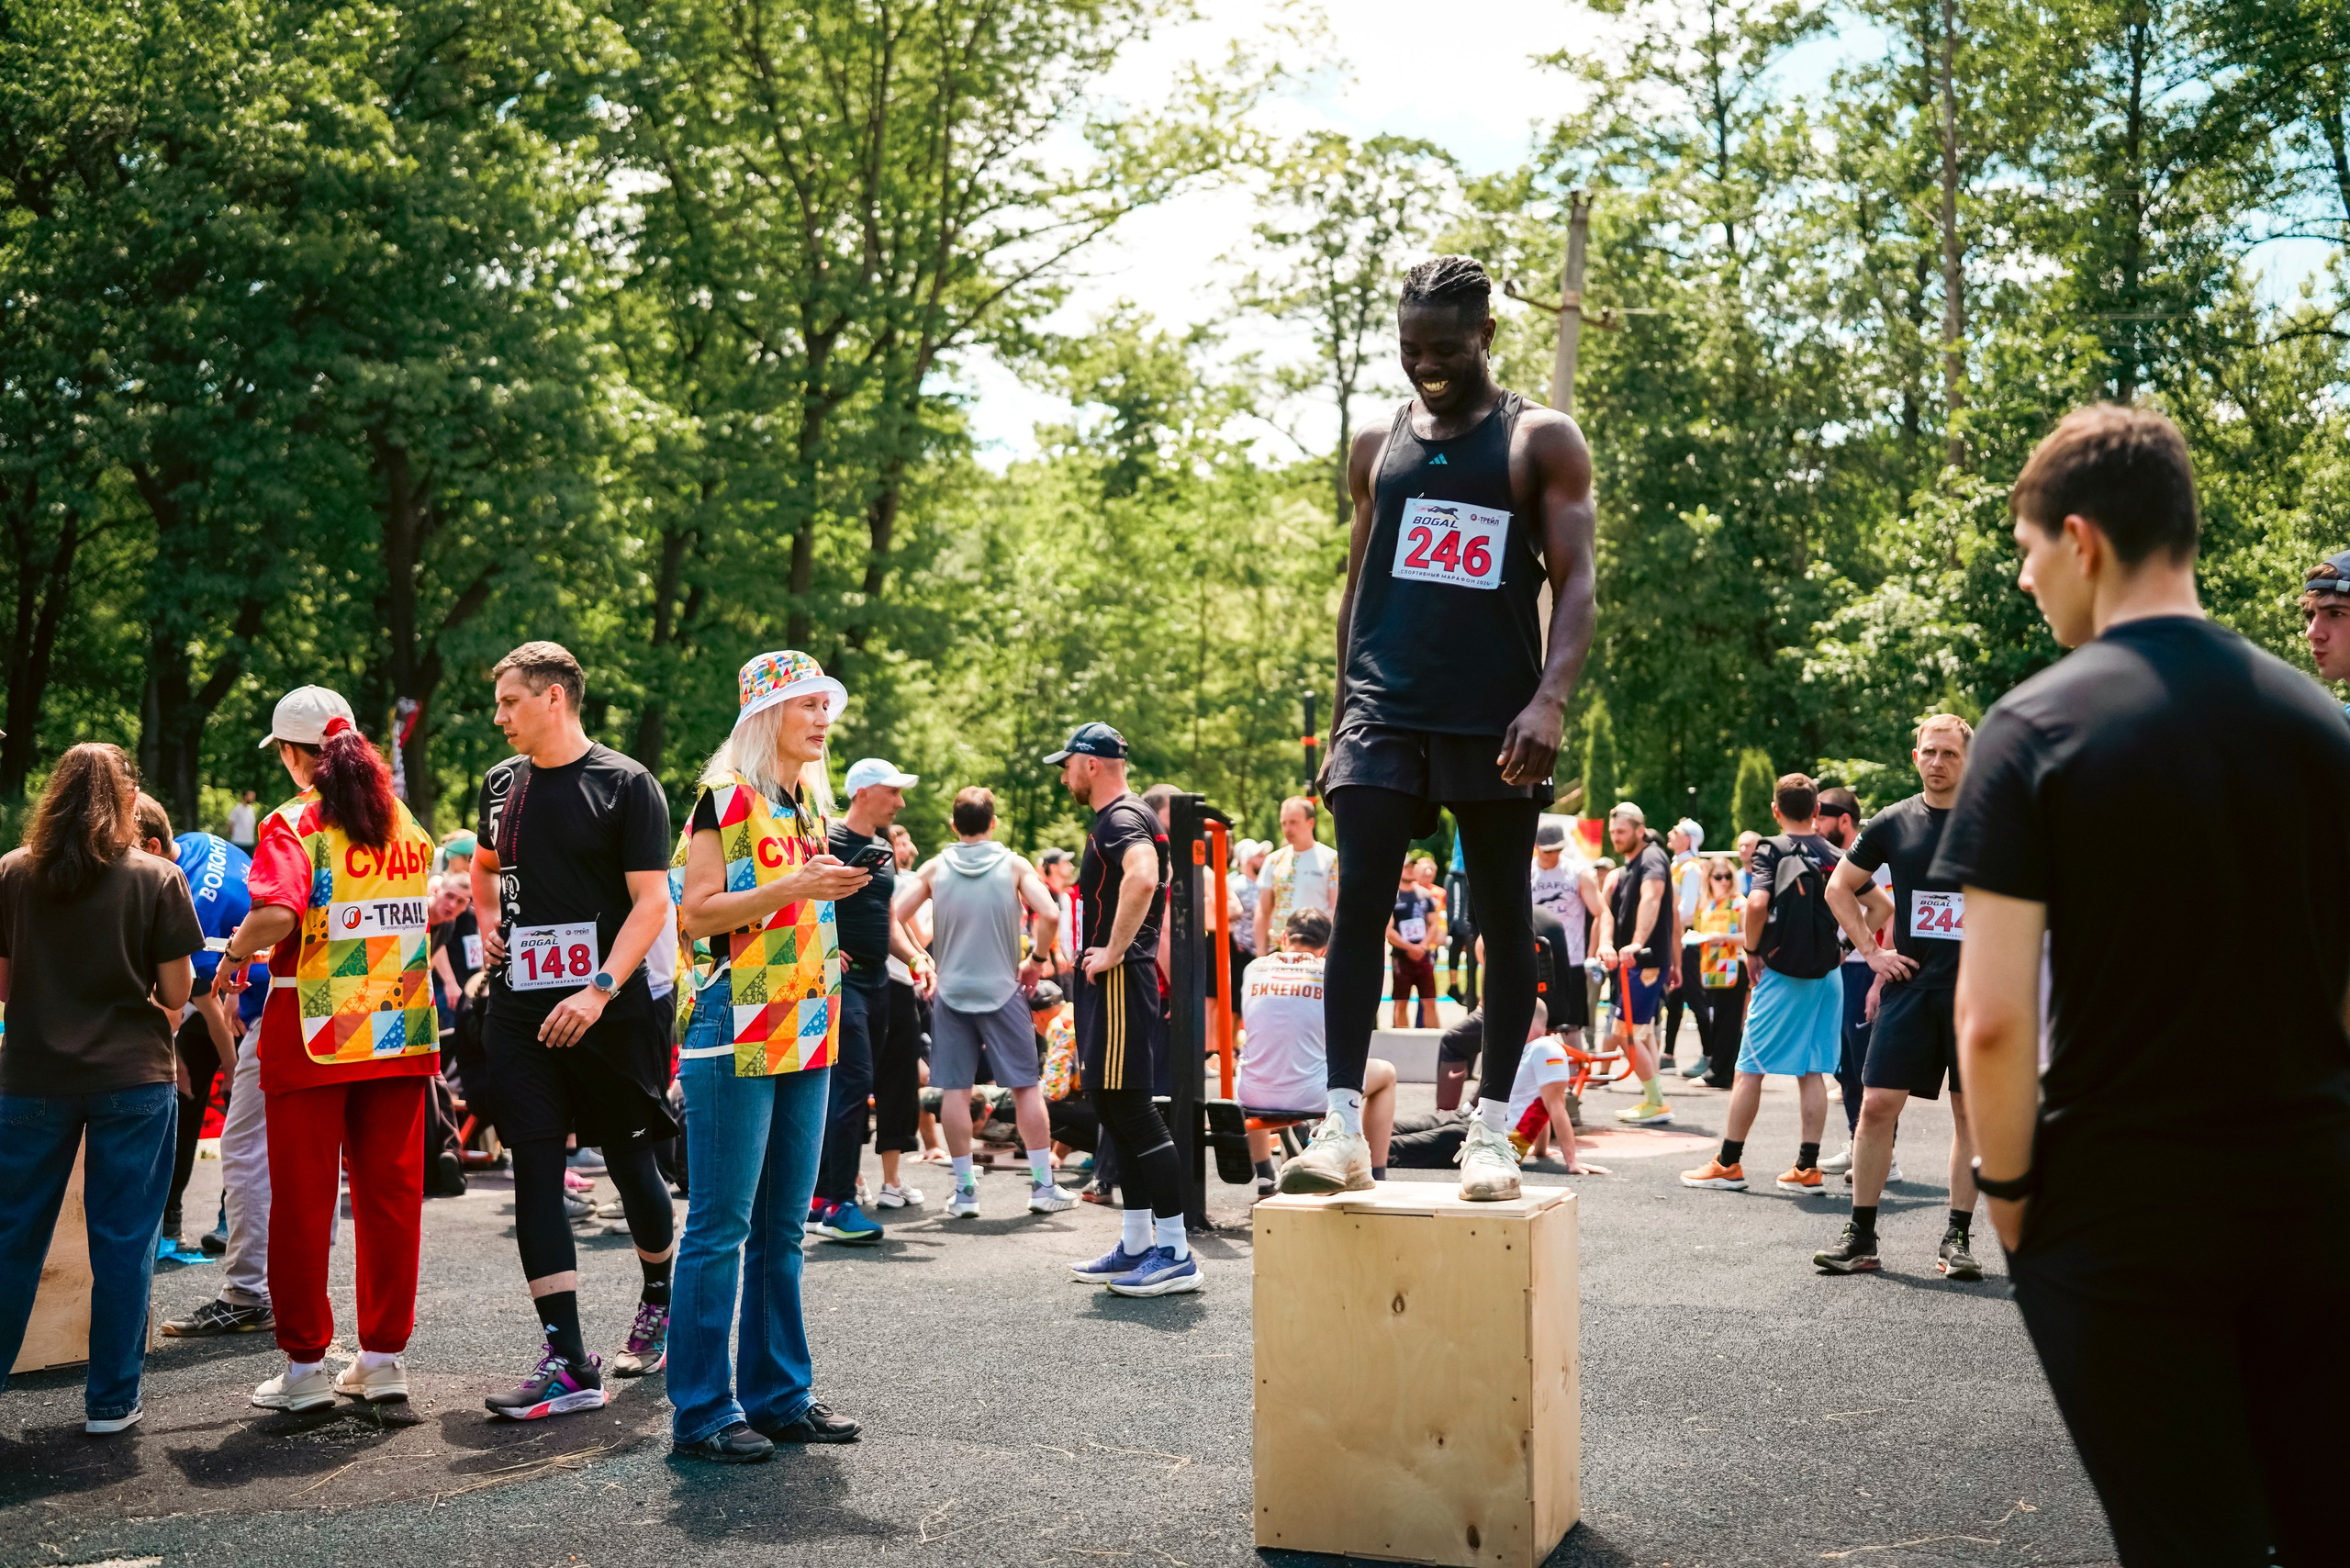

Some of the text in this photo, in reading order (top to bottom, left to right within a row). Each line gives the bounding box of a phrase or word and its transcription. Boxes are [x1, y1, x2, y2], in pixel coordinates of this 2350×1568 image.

[1413, 516, 1459, 529] BOGAL
[1404, 526, 1492, 577] 246
[1400, 569, 1440, 578] СПОРТИВНЫЙ
[1441, 574, 1475, 584] МАРАФОН
[520, 938, 558, 947] BOGAL
[520, 943, 592, 980] 148
[1251, 982, 1323, 1000] БИЧЕНОВ
